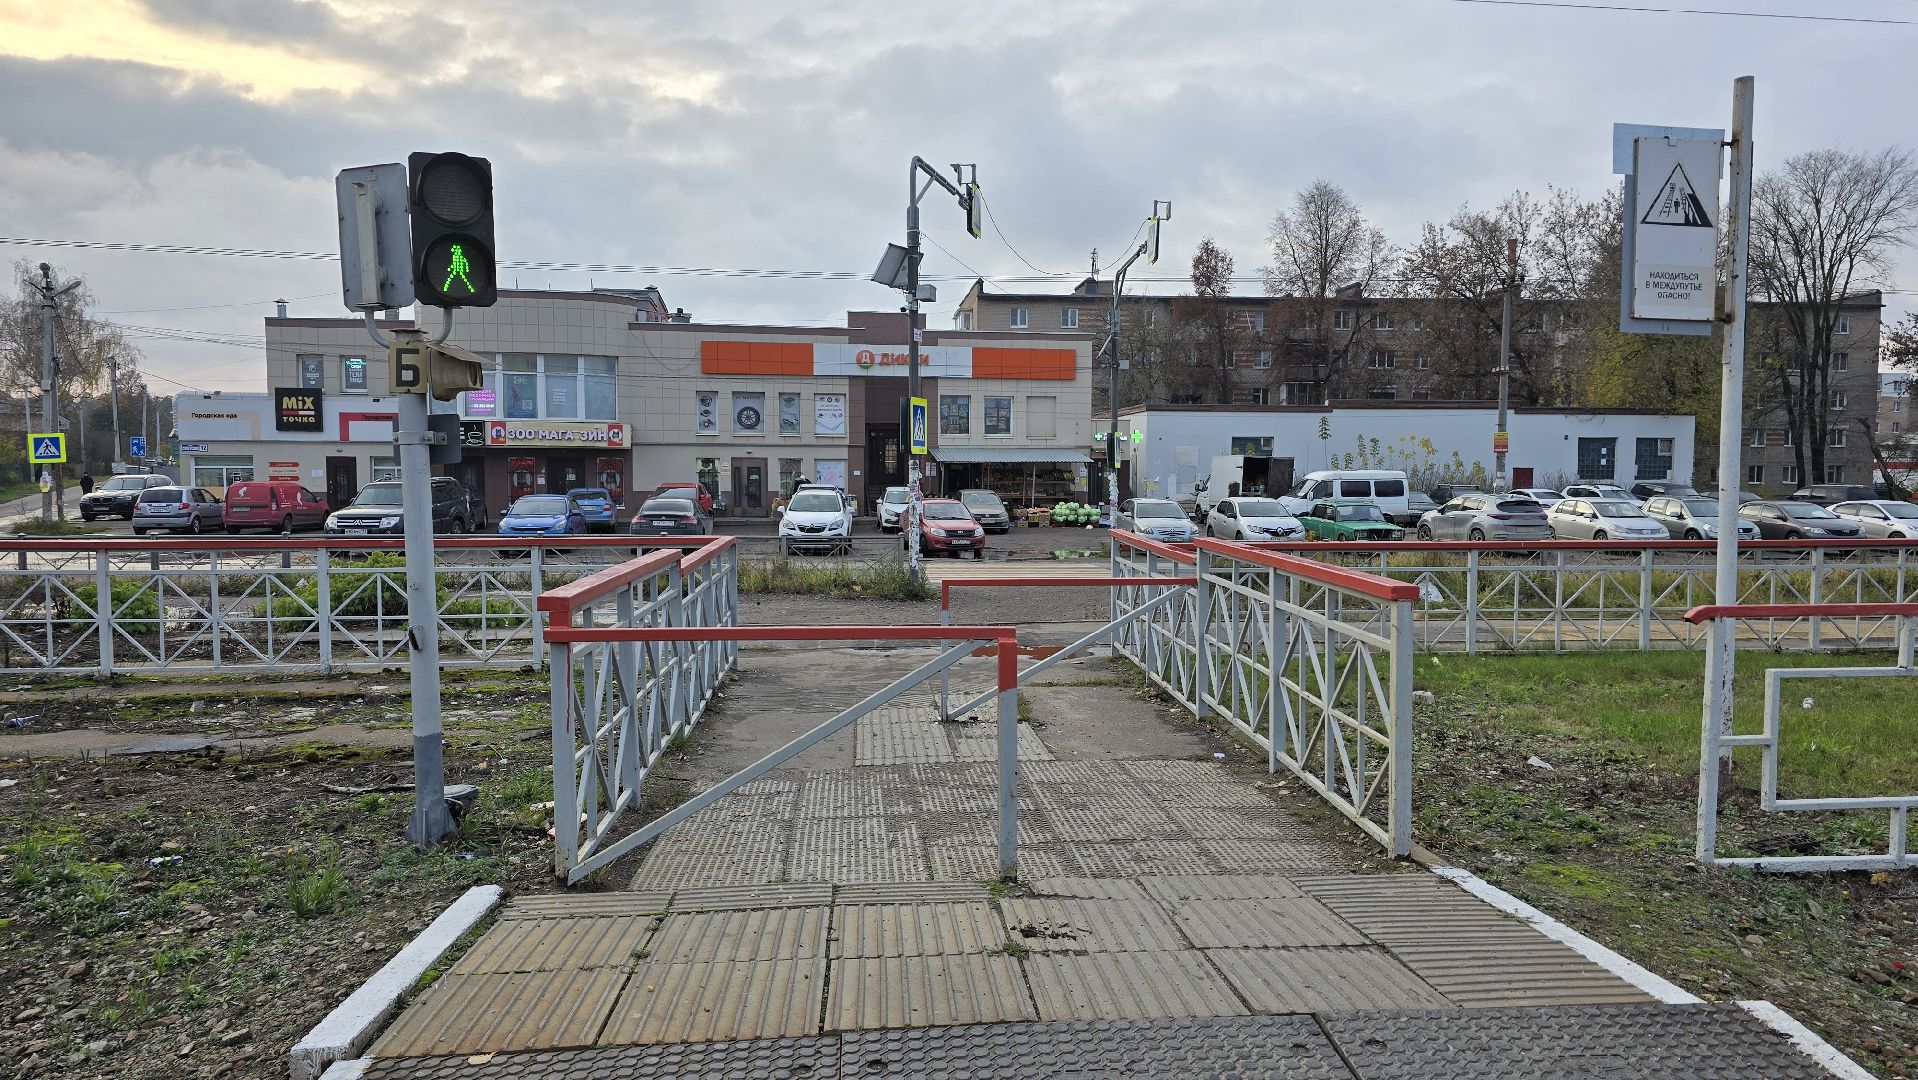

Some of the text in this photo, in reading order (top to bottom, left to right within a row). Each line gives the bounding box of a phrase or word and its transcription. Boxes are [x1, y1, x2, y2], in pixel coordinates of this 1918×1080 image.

[1649, 271, 1699, 281] НАХОДИТЬСЯ
[1645, 280, 1703, 291] В МЕЖДУПУТЬЕ
[1657, 291, 1691, 300] ОПАСНО!
[395, 347, 420, 388] Б
[282, 396, 315, 409] MiX
[507, 428, 608, 442] ЗОО МАГА ЗИН
